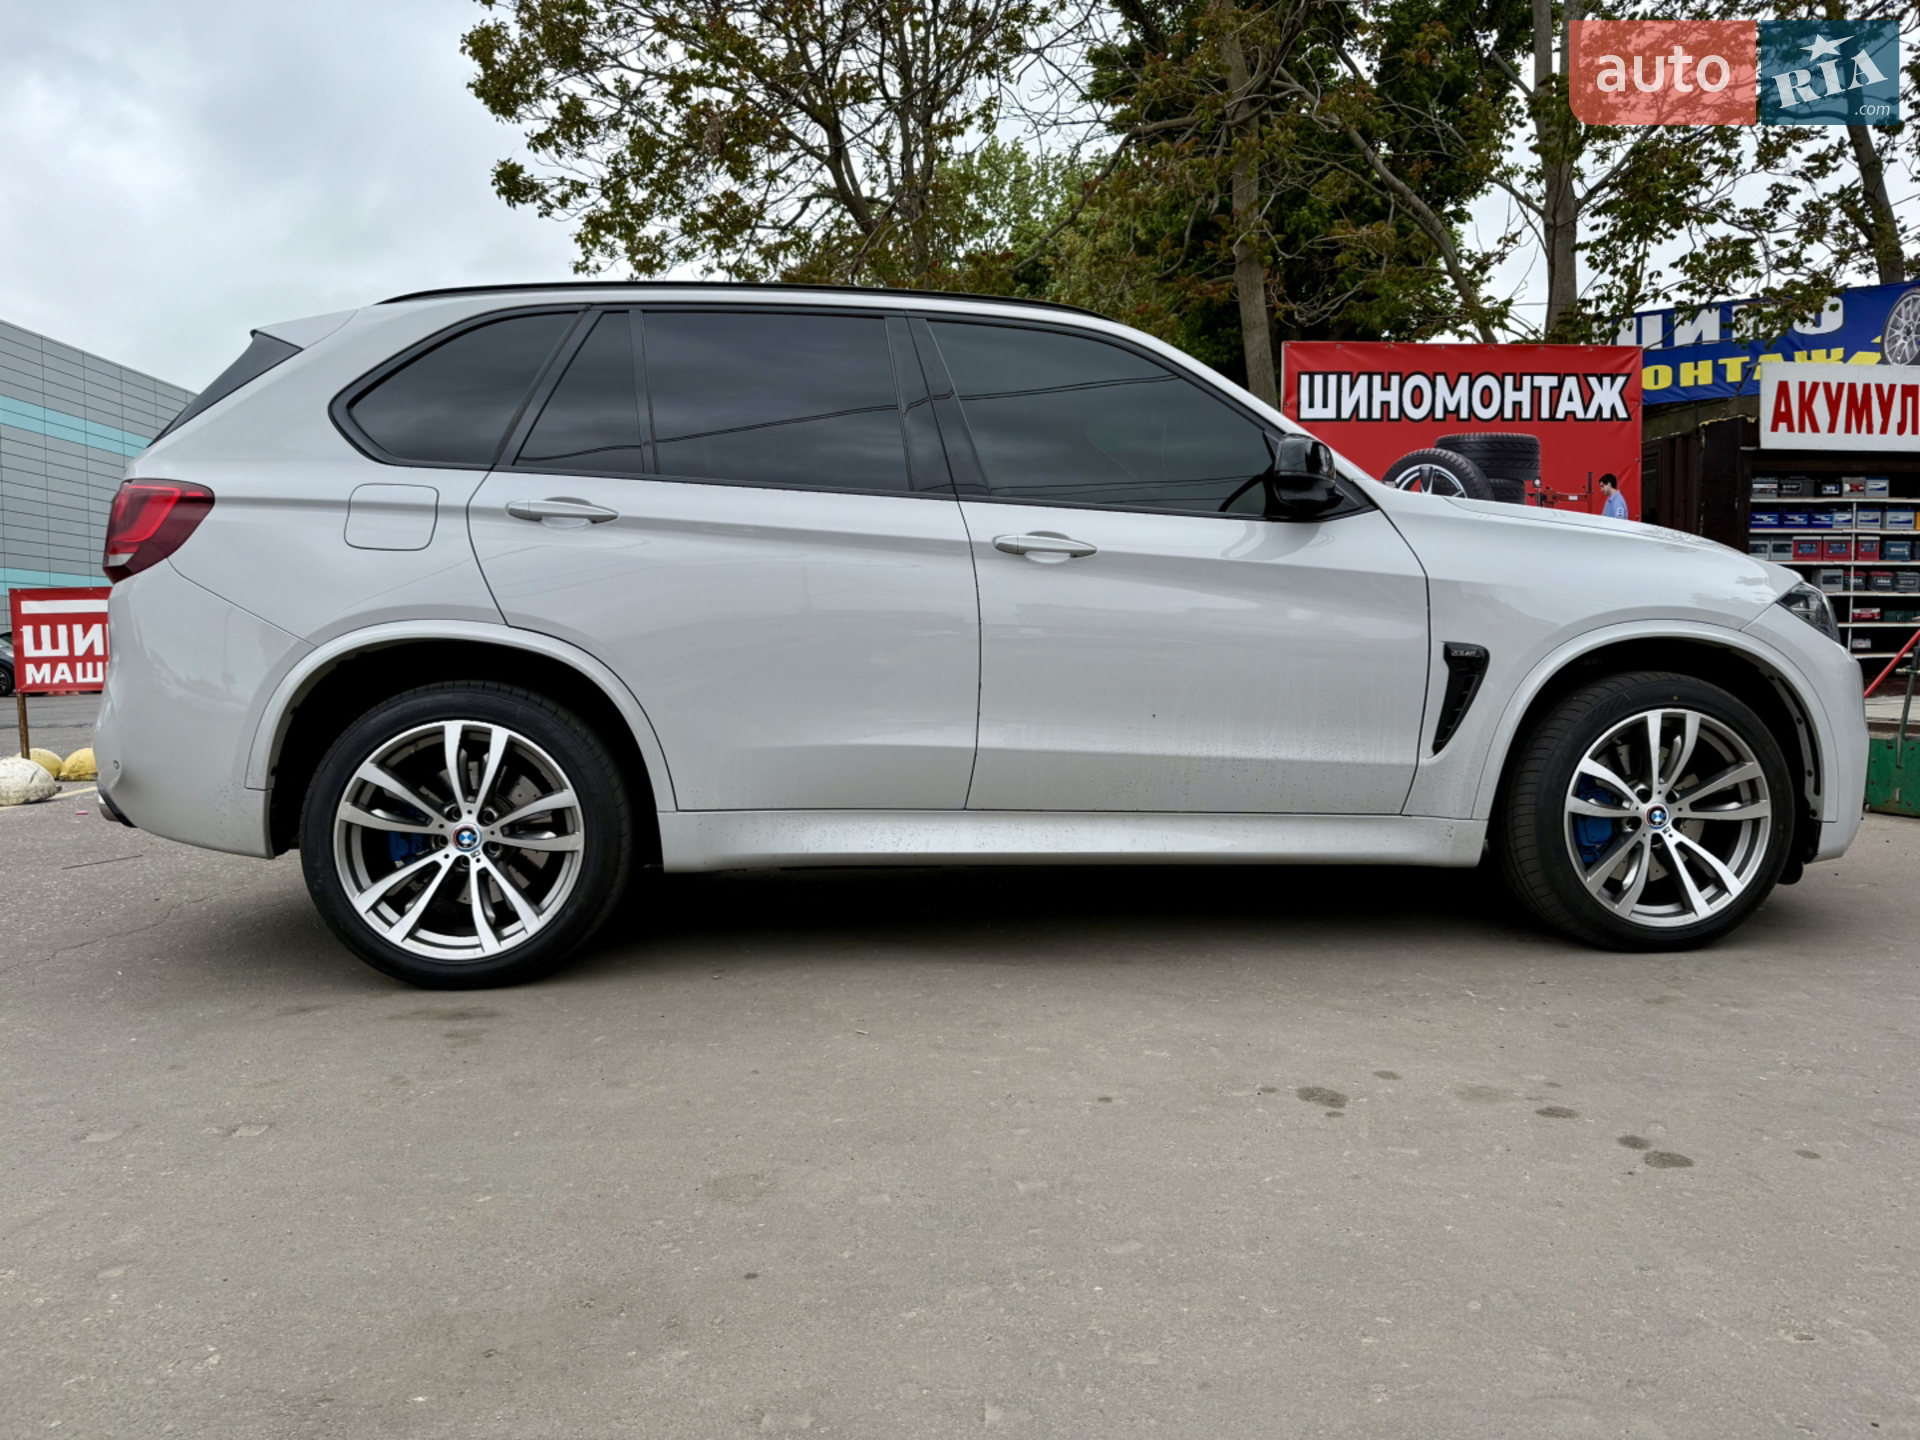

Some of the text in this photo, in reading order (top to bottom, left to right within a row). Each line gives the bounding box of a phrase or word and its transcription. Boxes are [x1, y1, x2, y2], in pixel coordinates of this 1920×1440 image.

[1298, 372, 1631, 421] ШИНОМОНТАЖ
[1770, 380, 1919, 436] АКУМУЛ
[22, 623, 109, 657] ШИ
[25, 661, 109, 684] МАШ
